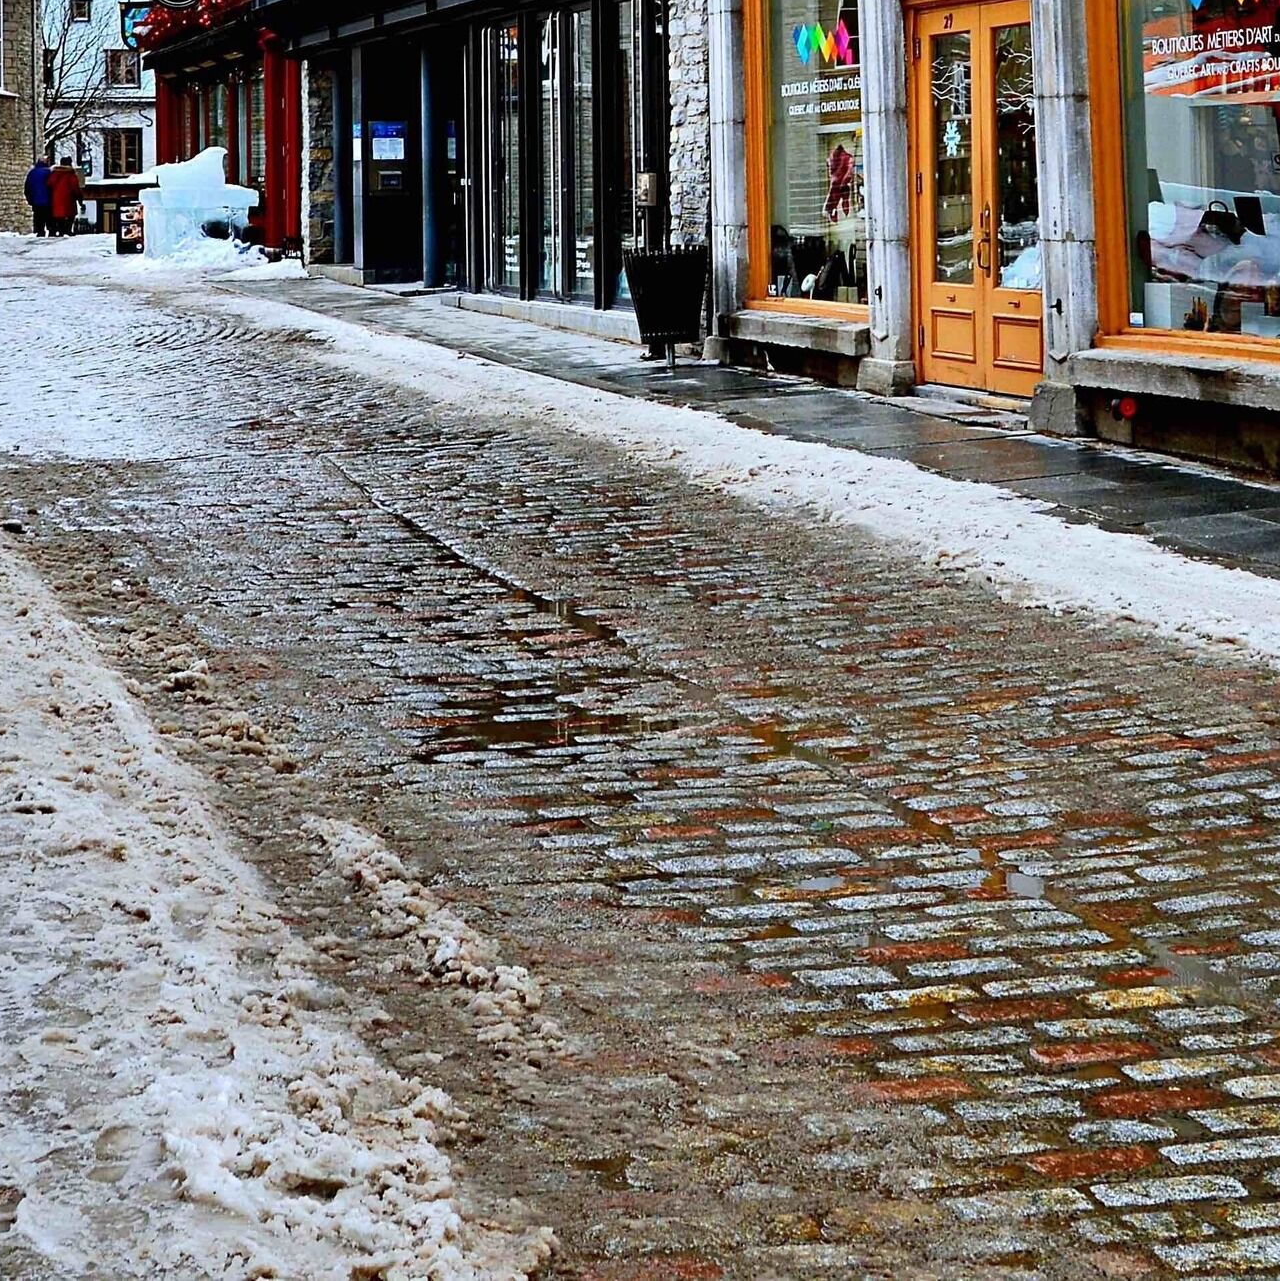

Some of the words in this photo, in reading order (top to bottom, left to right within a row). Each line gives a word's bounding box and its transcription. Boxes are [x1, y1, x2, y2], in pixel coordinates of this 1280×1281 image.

[1151, 34, 1204, 55] BOUTIQUES
[1207, 28, 1245, 51] MÉTIERS
[1246, 25, 1273, 44] D'ART
[1230, 59, 1259, 74] CRAFTS
